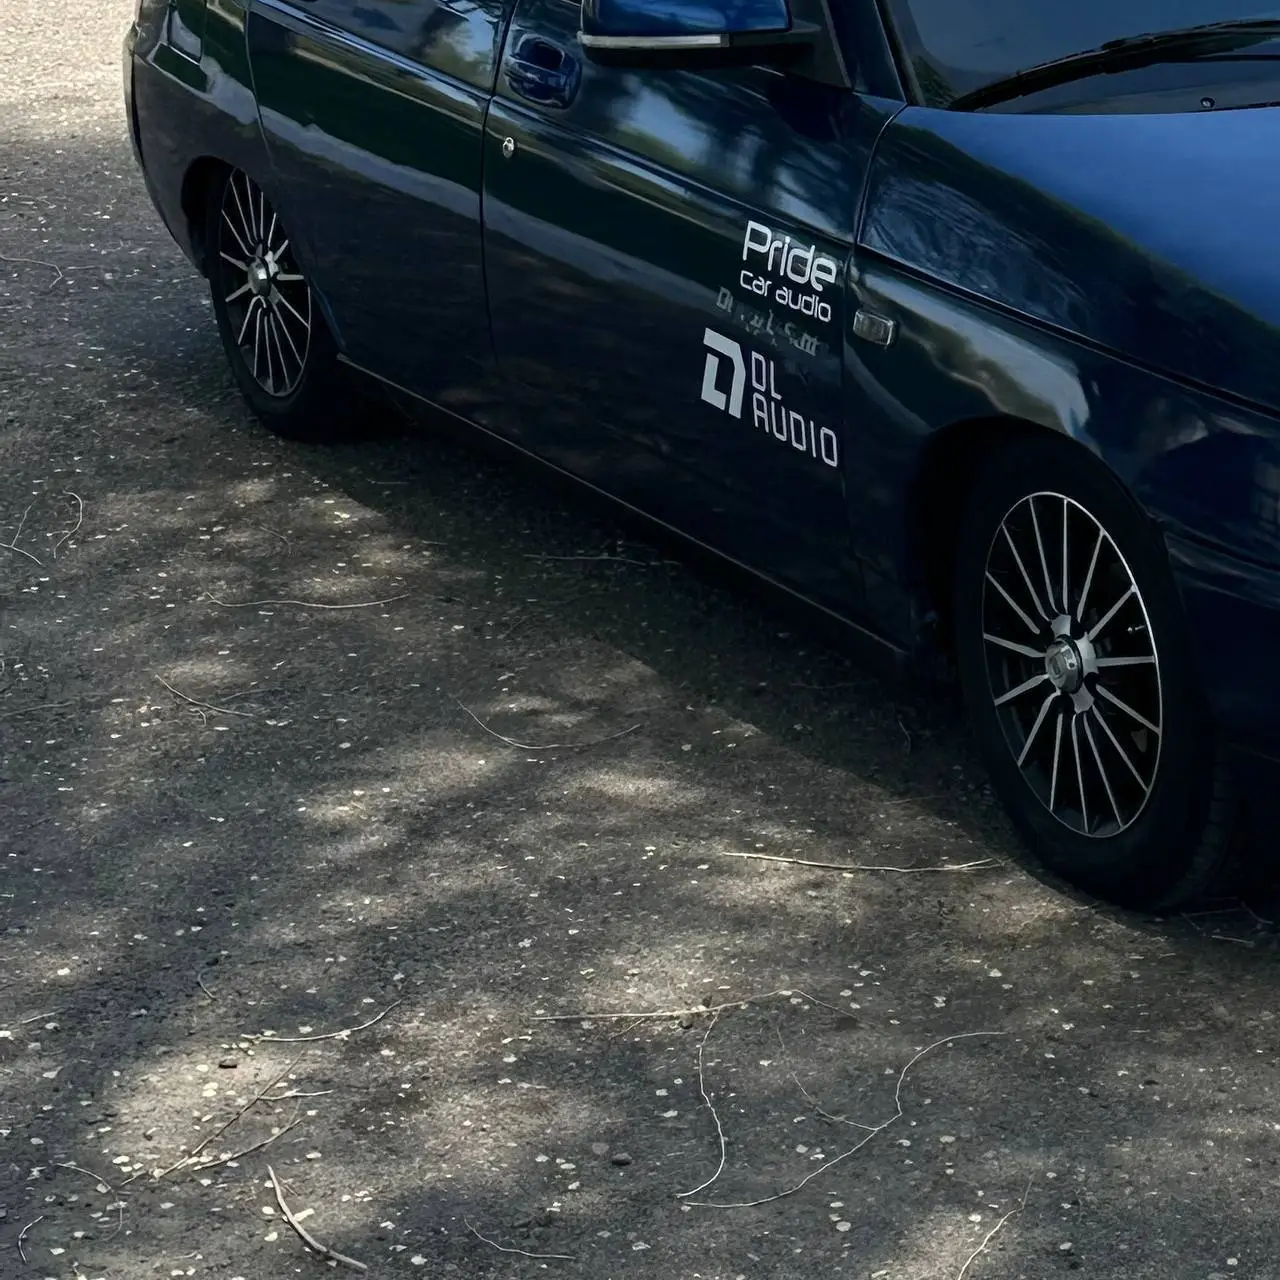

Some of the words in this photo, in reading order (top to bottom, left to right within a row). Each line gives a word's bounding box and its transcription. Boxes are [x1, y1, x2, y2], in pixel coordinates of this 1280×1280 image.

[742, 220, 838, 291] Pride
[740, 269, 772, 297] car
[775, 286, 832, 323] audio
[751, 350, 782, 400] DL
[753, 392, 838, 468] AUDIO
